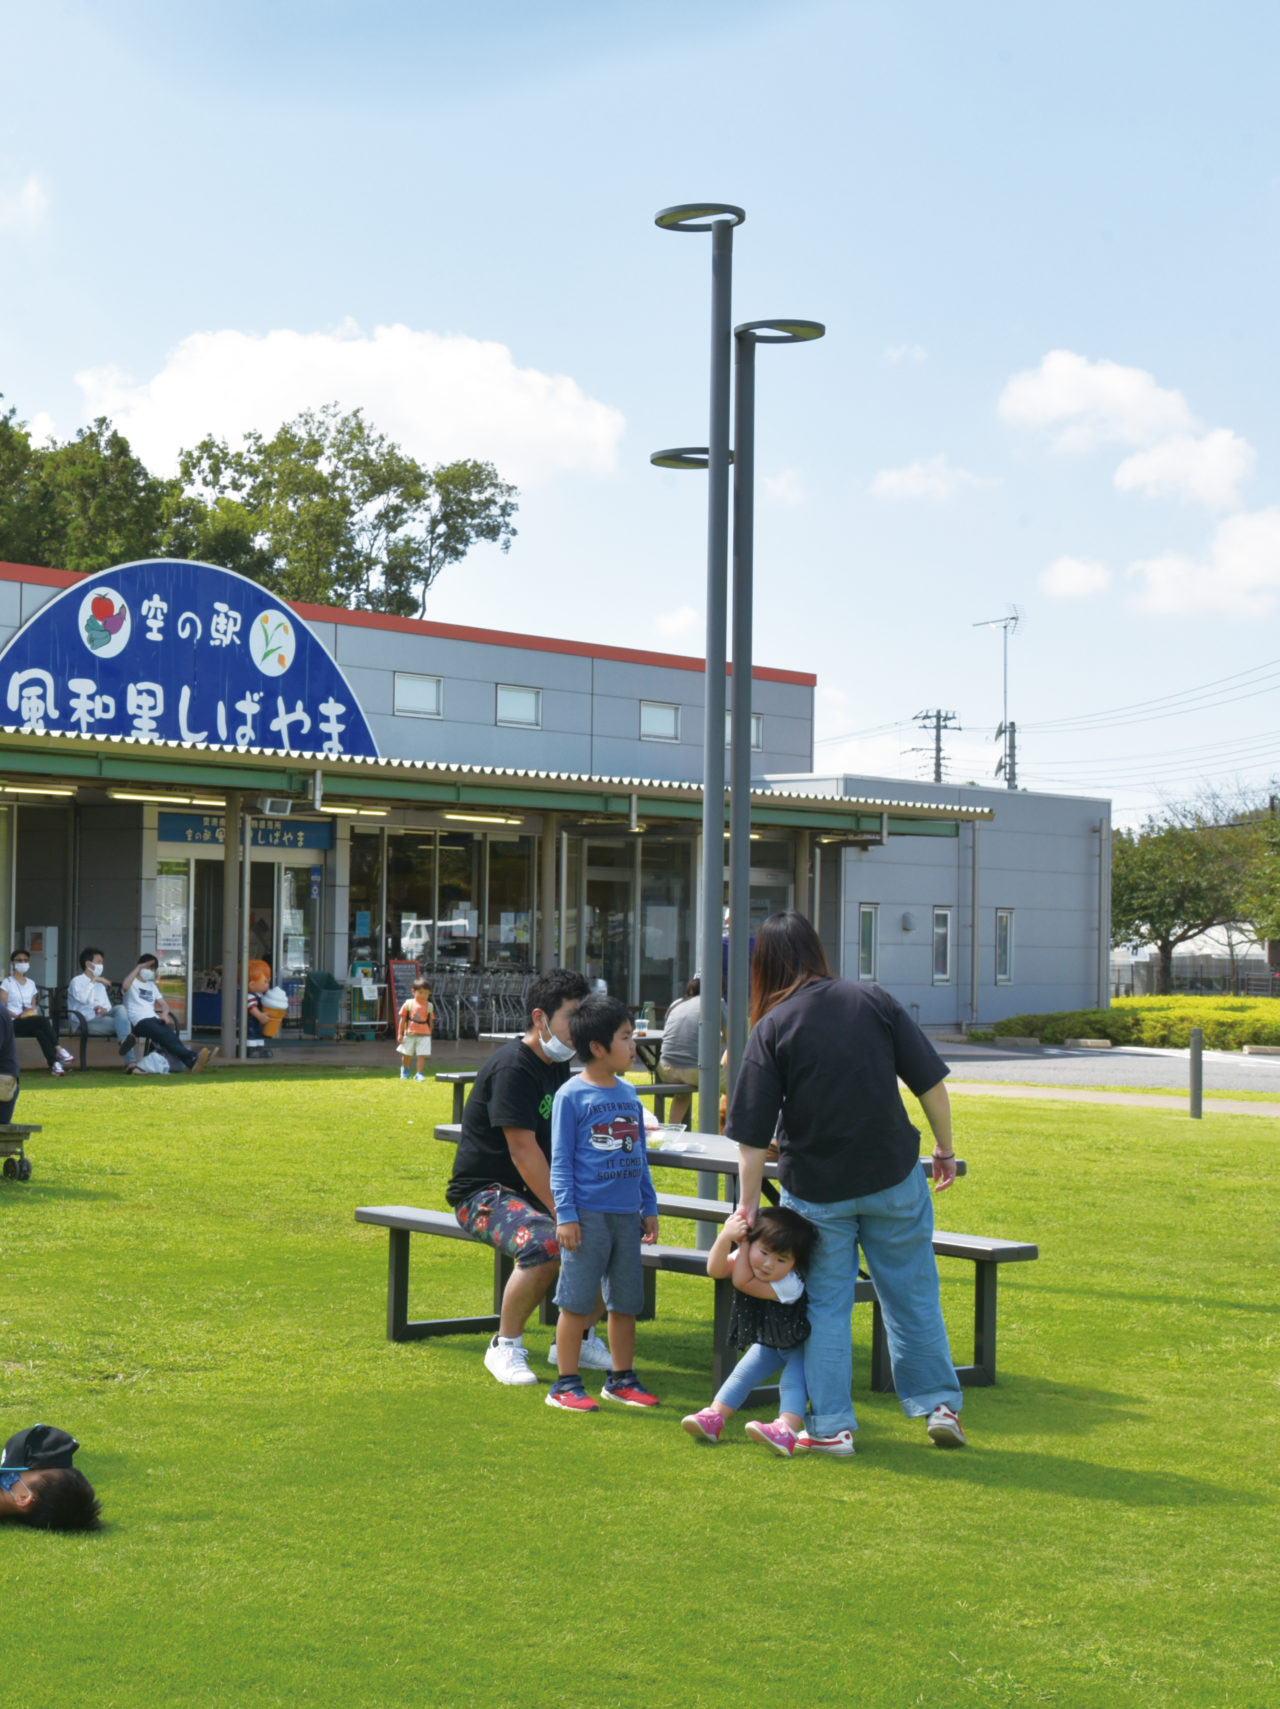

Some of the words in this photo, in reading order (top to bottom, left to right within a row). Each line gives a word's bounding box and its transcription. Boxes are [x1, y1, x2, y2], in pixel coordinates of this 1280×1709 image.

[141, 593, 241, 647] 空の駅
[7, 668, 346, 753] 風和里しばやま
